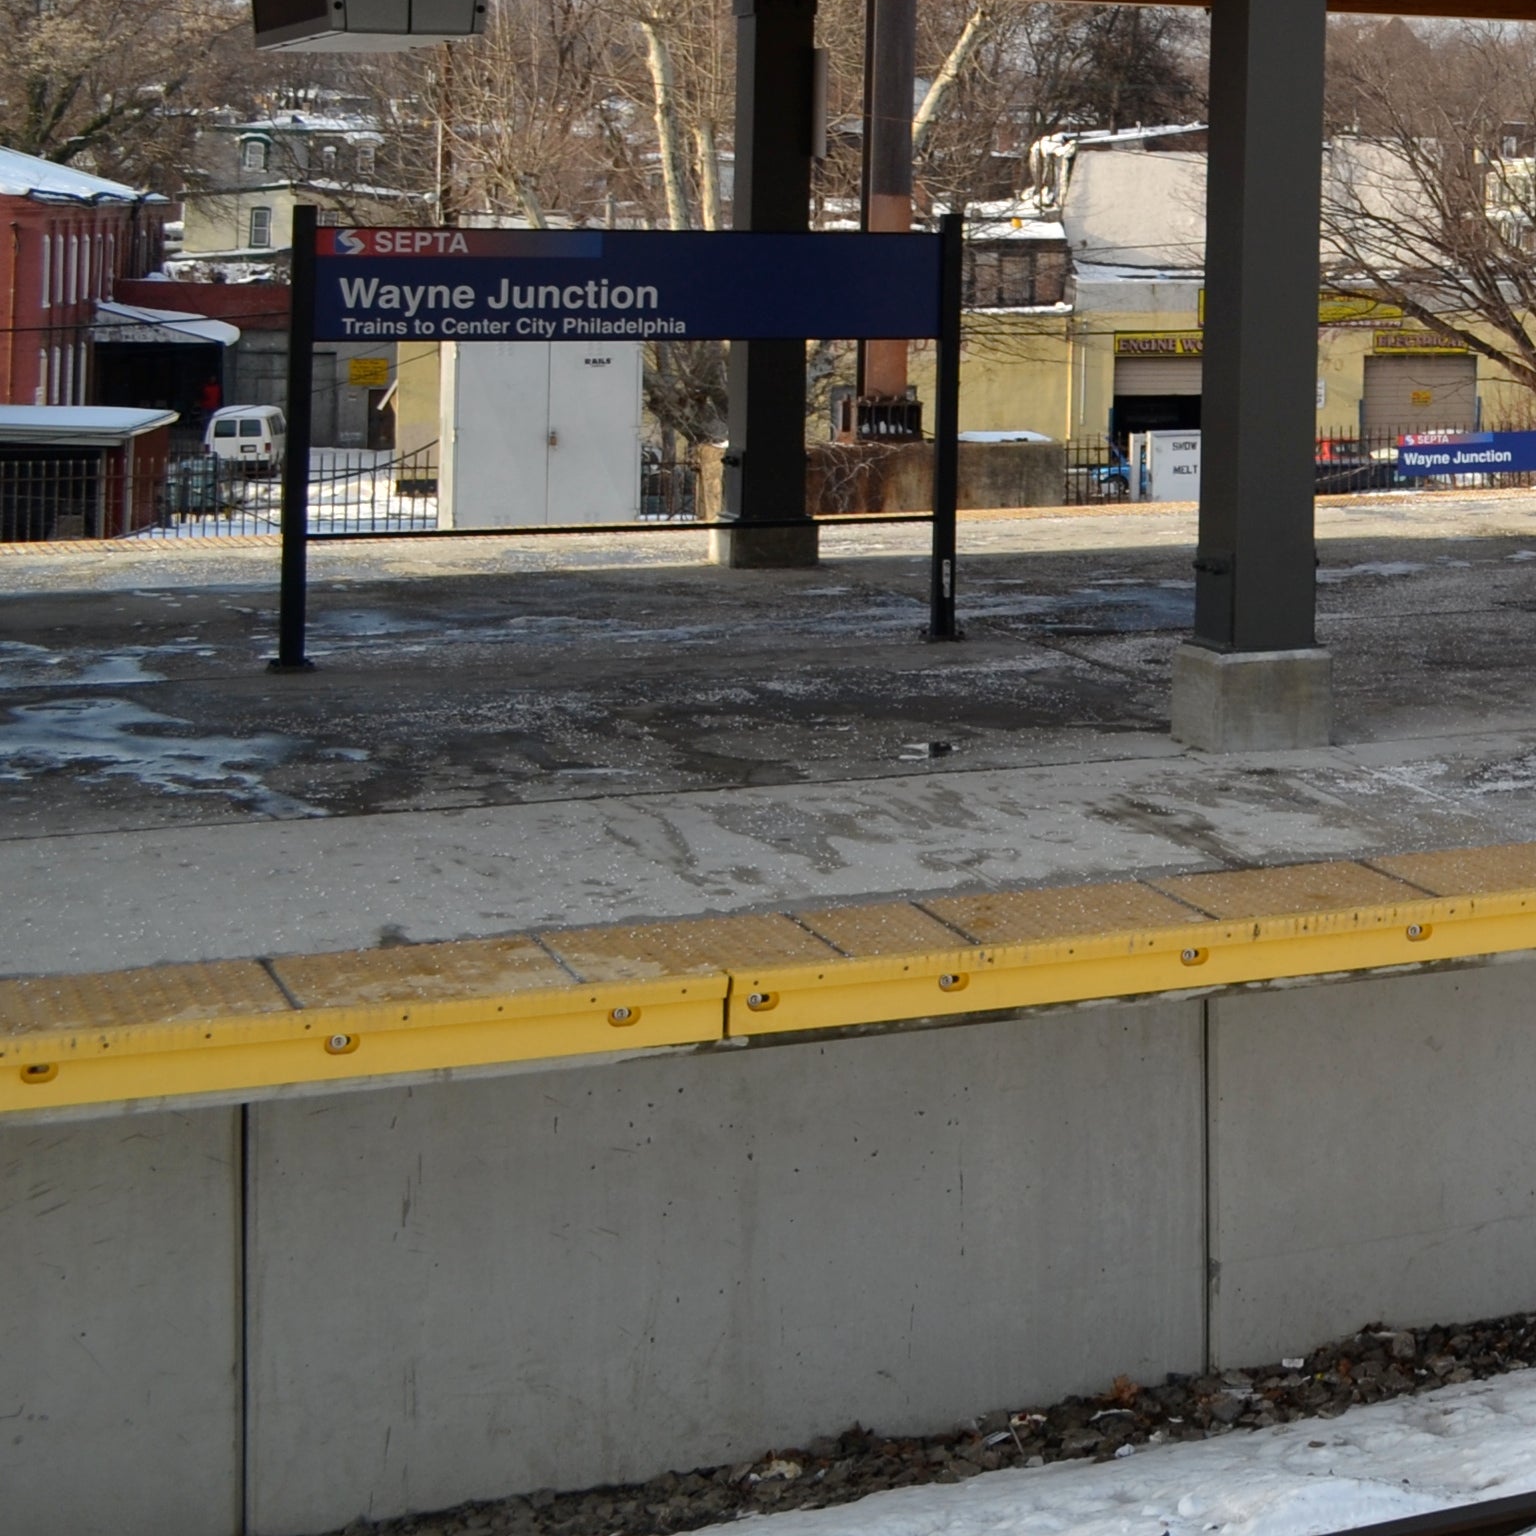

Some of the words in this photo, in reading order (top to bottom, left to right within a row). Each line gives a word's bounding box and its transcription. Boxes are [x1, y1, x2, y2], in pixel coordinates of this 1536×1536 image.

[375, 231, 469, 253] SEPTA
[339, 277, 476, 317] Wayne
[488, 278, 659, 310] Junction
[342, 318, 408, 335] Trains
[414, 319, 435, 335] to
[441, 318, 510, 335] Center
[516, 318, 556, 338] City
[563, 318, 686, 338] Philadelphia
[1119, 338, 1177, 352] ENGINE
[1417, 435, 1450, 445] SEPTA
[1404, 452, 1450, 468] Wayne
[1453, 449, 1512, 464] Junction
[1173, 465, 1198, 475] MELT
